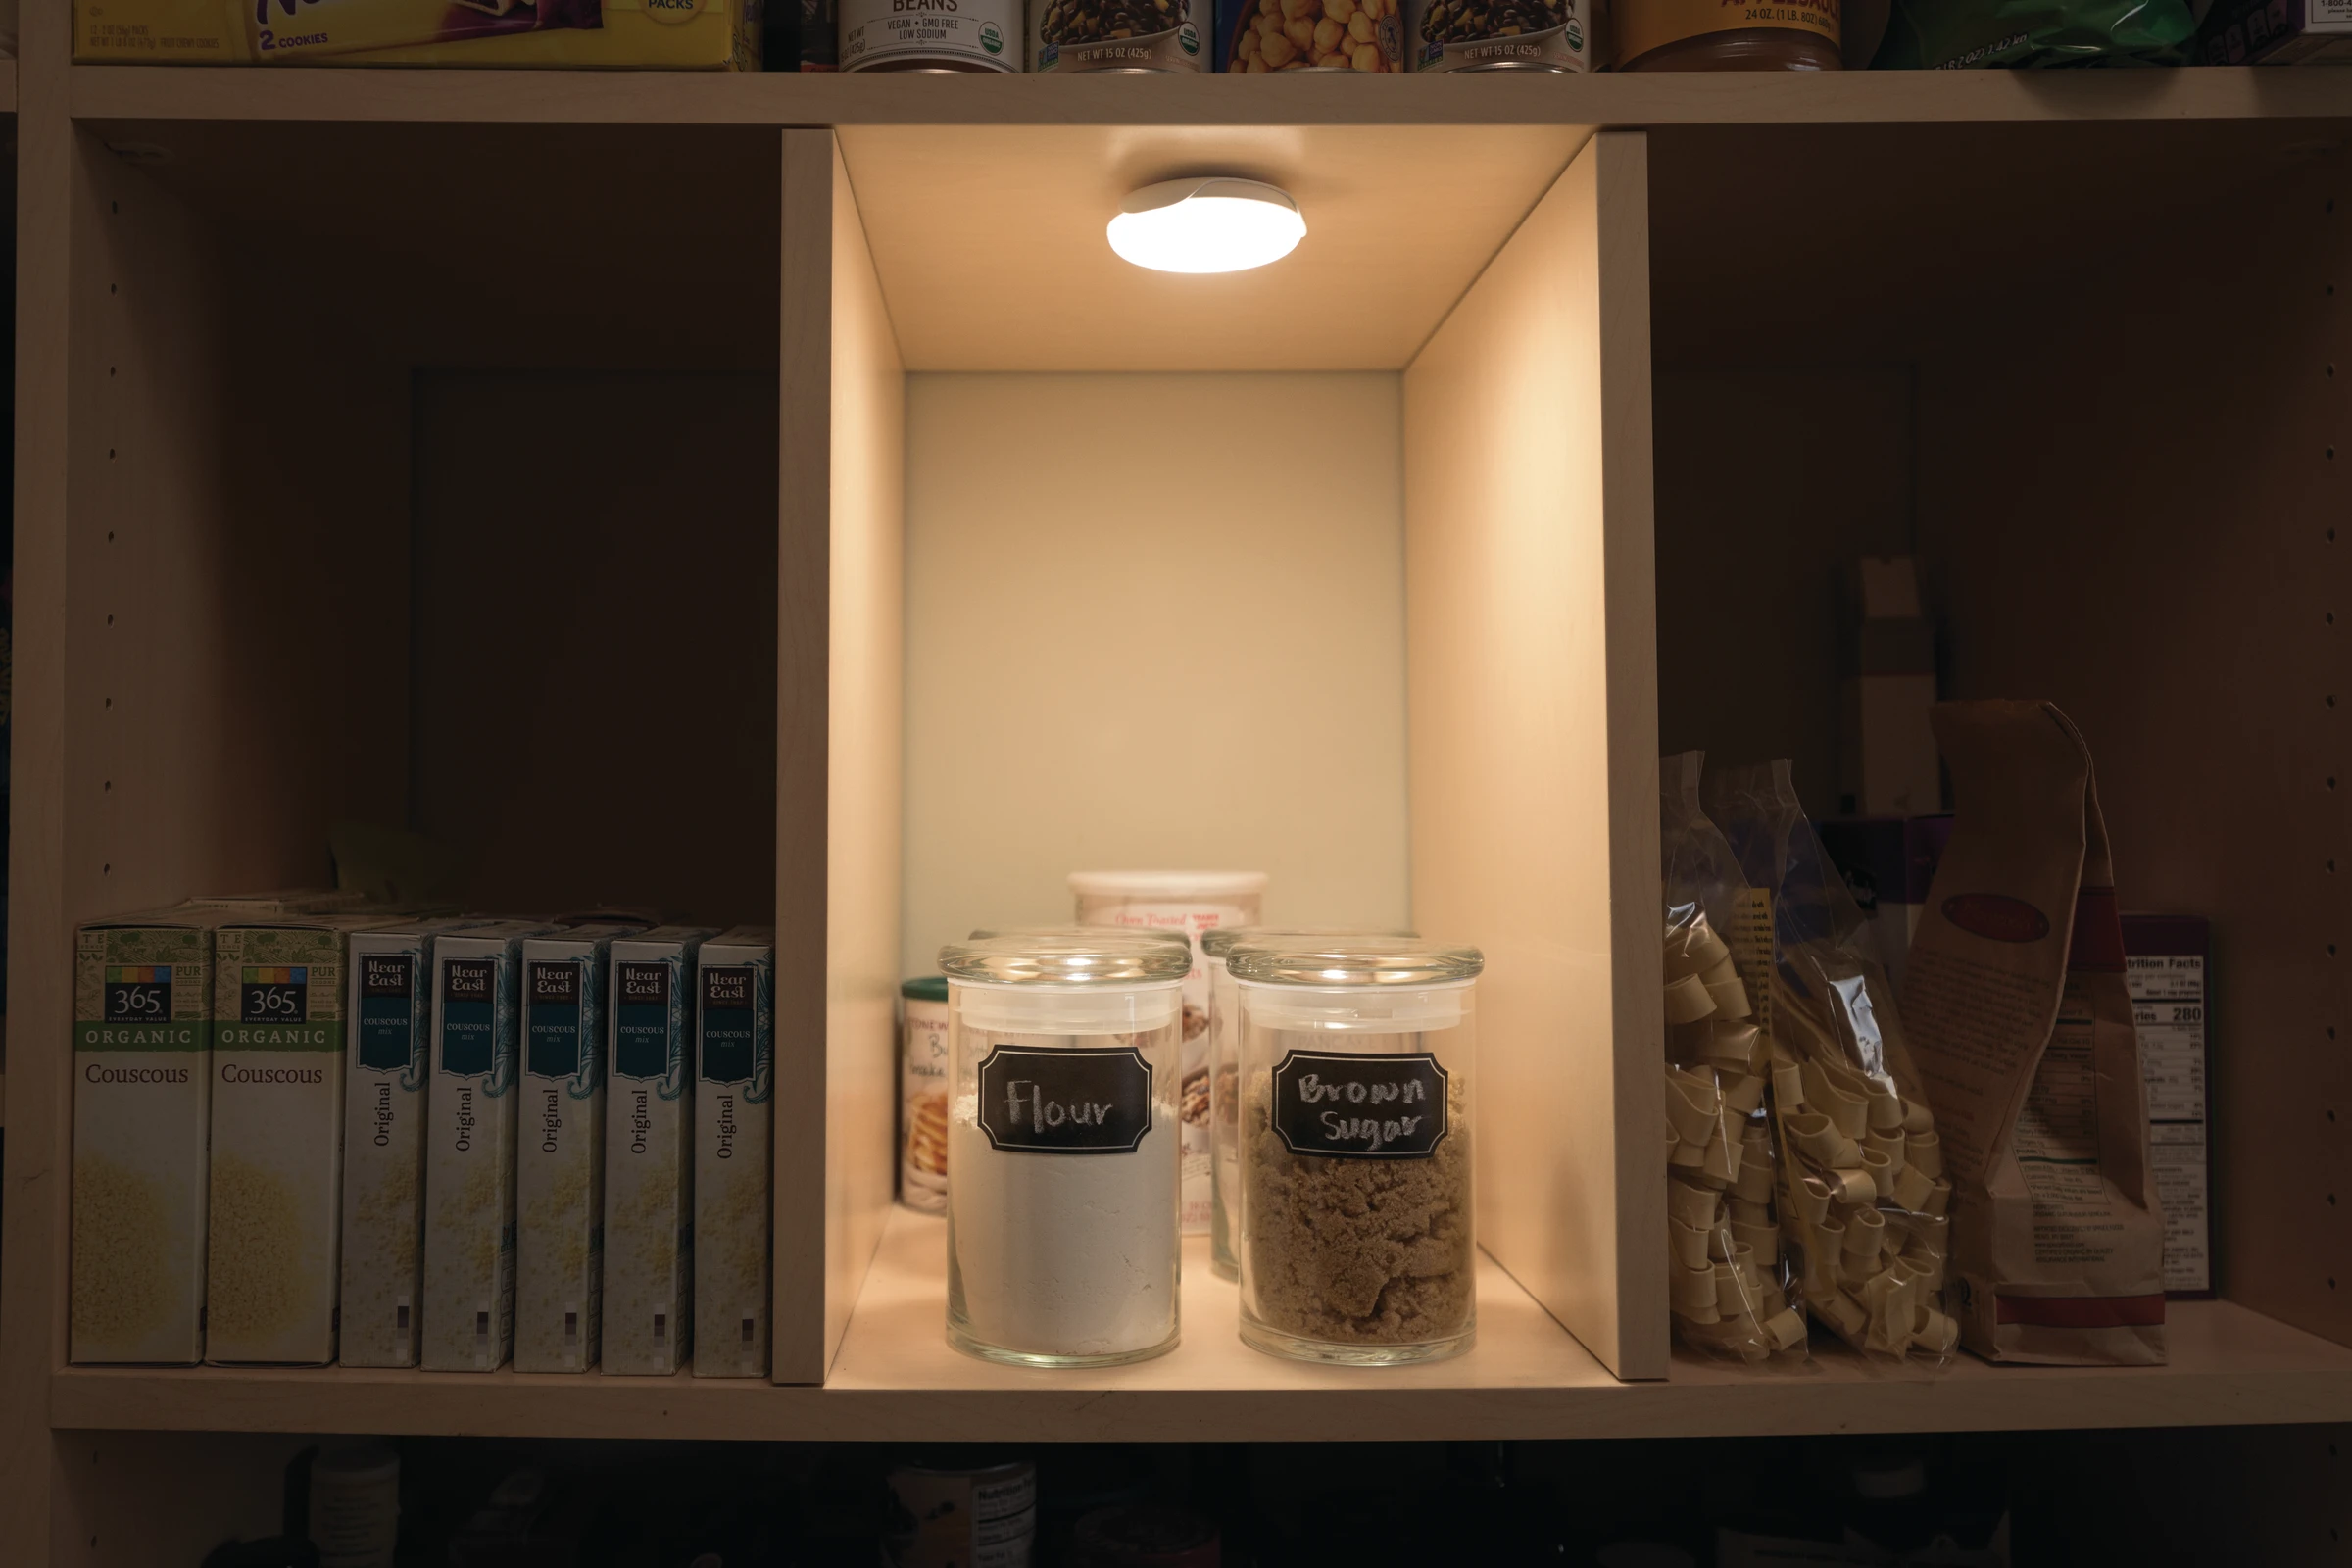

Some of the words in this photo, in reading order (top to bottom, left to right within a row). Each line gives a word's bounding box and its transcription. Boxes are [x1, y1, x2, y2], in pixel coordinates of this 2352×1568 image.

[893, 0, 958, 12] BEANS
[1745, 9, 1758, 20] 24
[1759, 9, 1775, 20] OZ.
[888, 18, 911, 30] VEGAN
[922, 18, 939, 28] GMO
[941, 20, 959, 30] FREE
[259, 30, 277, 50] 2
[278, 32, 328, 48] COOKIES
[899, 29, 914, 40] LOW
[916, 29, 947, 40] SODIUM
[1077, 51, 1090, 62] NET
[1093, 49, 1103, 60] WT
[1105, 48, 1113, 59] 15
[1115, 47, 1126, 58] OZ
[1127, 47, 1152, 60] (425g)
[1464, 50, 1478, 60] NET
[1480, 48, 1493, 58] WT
[1494, 47, 1502, 56] 15
[1504, 46, 1515, 56] OZ
[1516, 45, 1542, 57] (425g)
[368, 961, 406, 974] Near
[452, 964, 488, 978] Near
[2127, 959, 2164, 969] trition
[2169, 959, 2201, 969] Facts
[368, 973, 404, 987] East
[536, 968, 573, 981] Near
[625, 968, 662, 981] Near
[710, 973, 747, 986] Near
[452, 978, 486, 992] East
[536, 980, 572, 994] East
[625, 981, 662, 994] East
[114, 985, 162, 1014] 365
[710, 986, 746, 999] East
[250, 986, 297, 1015] 365
[2135, 1012, 2157, 1022] ries
[2173, 1006, 2202, 1022] 280
[447, 1023, 490, 1032] COUSCOUS
[532, 1025, 576, 1034] COUSCOUS
[620, 1026, 664, 1035] COUSCOUS
[706, 1030, 751, 1039] COUSCOUS
[85, 1030, 192, 1045] ORGANIC
[220, 1030, 326, 1045] ORGANIC
[461, 1032, 475, 1041] mix
[85, 1063, 189, 1084] Couscous
[220, 1063, 323, 1084] Couscous
[1298, 1074, 1427, 1105] Brown
[1004, 1080, 1114, 1134] Flour
[373, 1082, 394, 1147] Original
[455, 1087, 475, 1152] Original
[542, 1089, 562, 1153] Original
[630, 1090, 651, 1154] Original
[716, 1095, 737, 1159] Original
[1319, 1110, 1424, 1152] Sugar
